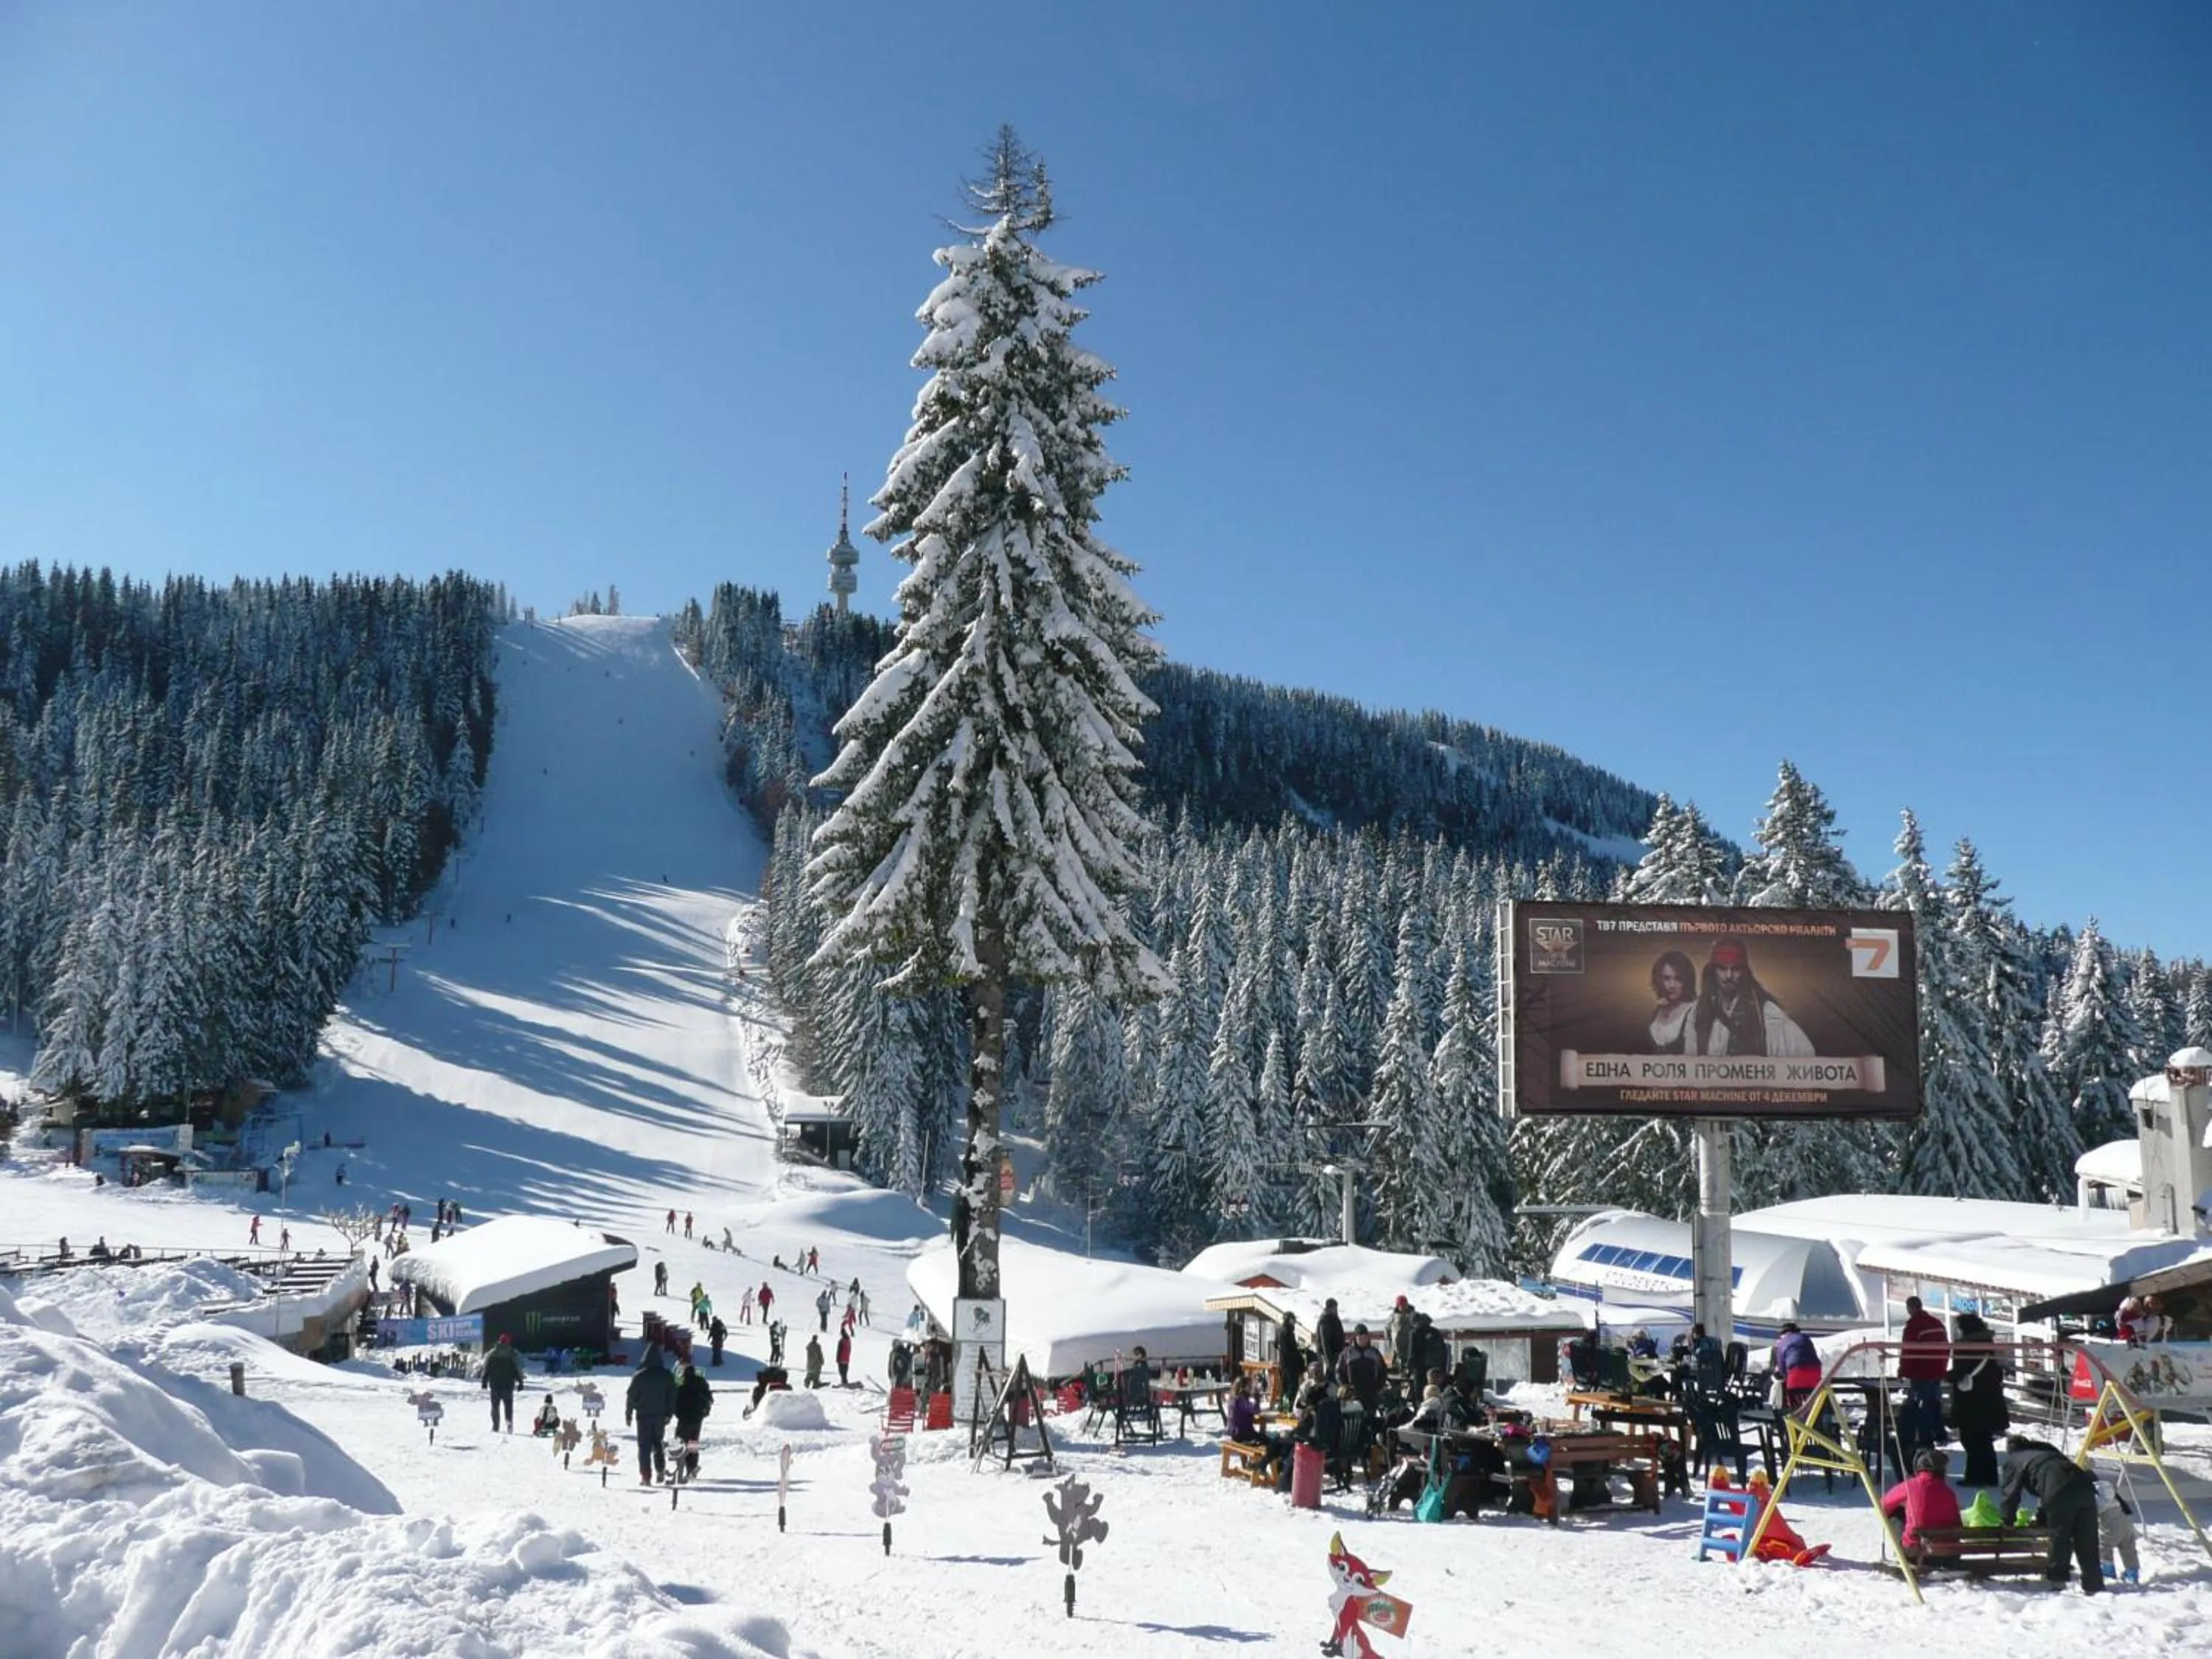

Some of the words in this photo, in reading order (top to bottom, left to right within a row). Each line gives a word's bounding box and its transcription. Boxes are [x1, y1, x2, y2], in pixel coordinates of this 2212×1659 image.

[1536, 926, 1574, 942] STAR
[1596, 920, 1615, 931] ТВ7
[1618, 921, 1677, 933] ПРЕДСТАВЯ
[1845, 938, 1891, 971] 7
[1586, 1062, 1631, 1078] ЕДНА
[1642, 1062, 1686, 1079] РОЛЯ
[1695, 1063, 1775, 1079] ПРОМЕНЯ
[1787, 1065, 1857, 1081] ЖИВОТА
[1621, 1088, 1672, 1101] ГЛЕДАЙТЕ
[427, 1321, 454, 1340] SKI
